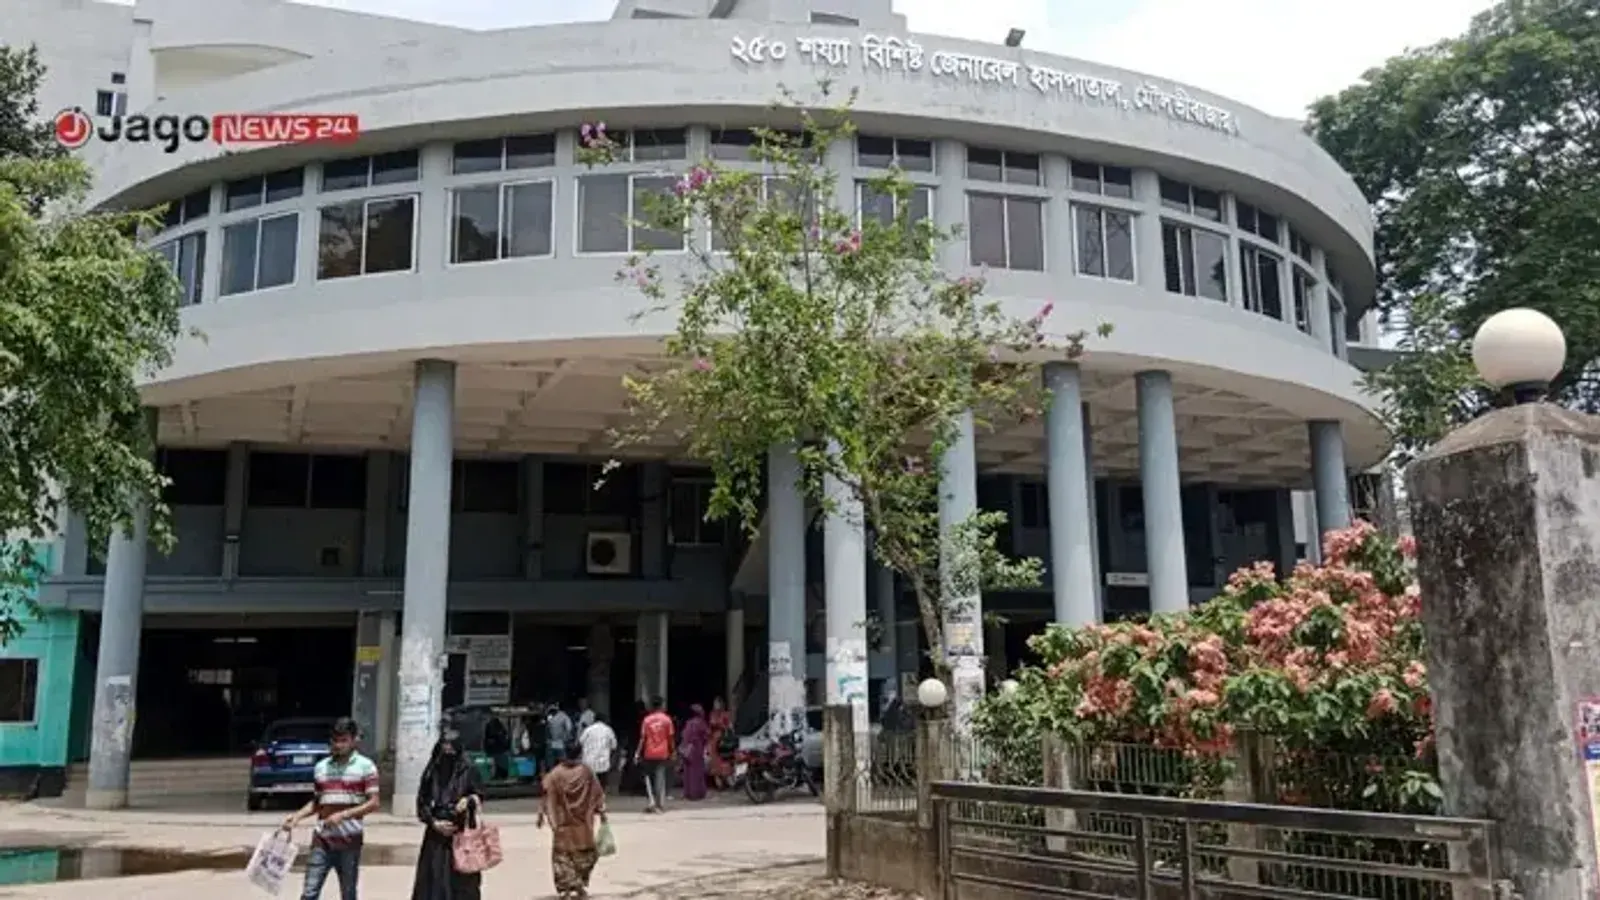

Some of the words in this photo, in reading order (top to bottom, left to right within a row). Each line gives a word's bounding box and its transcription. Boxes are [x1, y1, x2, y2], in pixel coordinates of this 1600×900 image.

[731, 35, 787, 63] ২৫০
[796, 35, 850, 65] শয্যা
[861, 34, 925, 71] বিশিষ্ট
[930, 51, 1021, 85] জেনারেল
